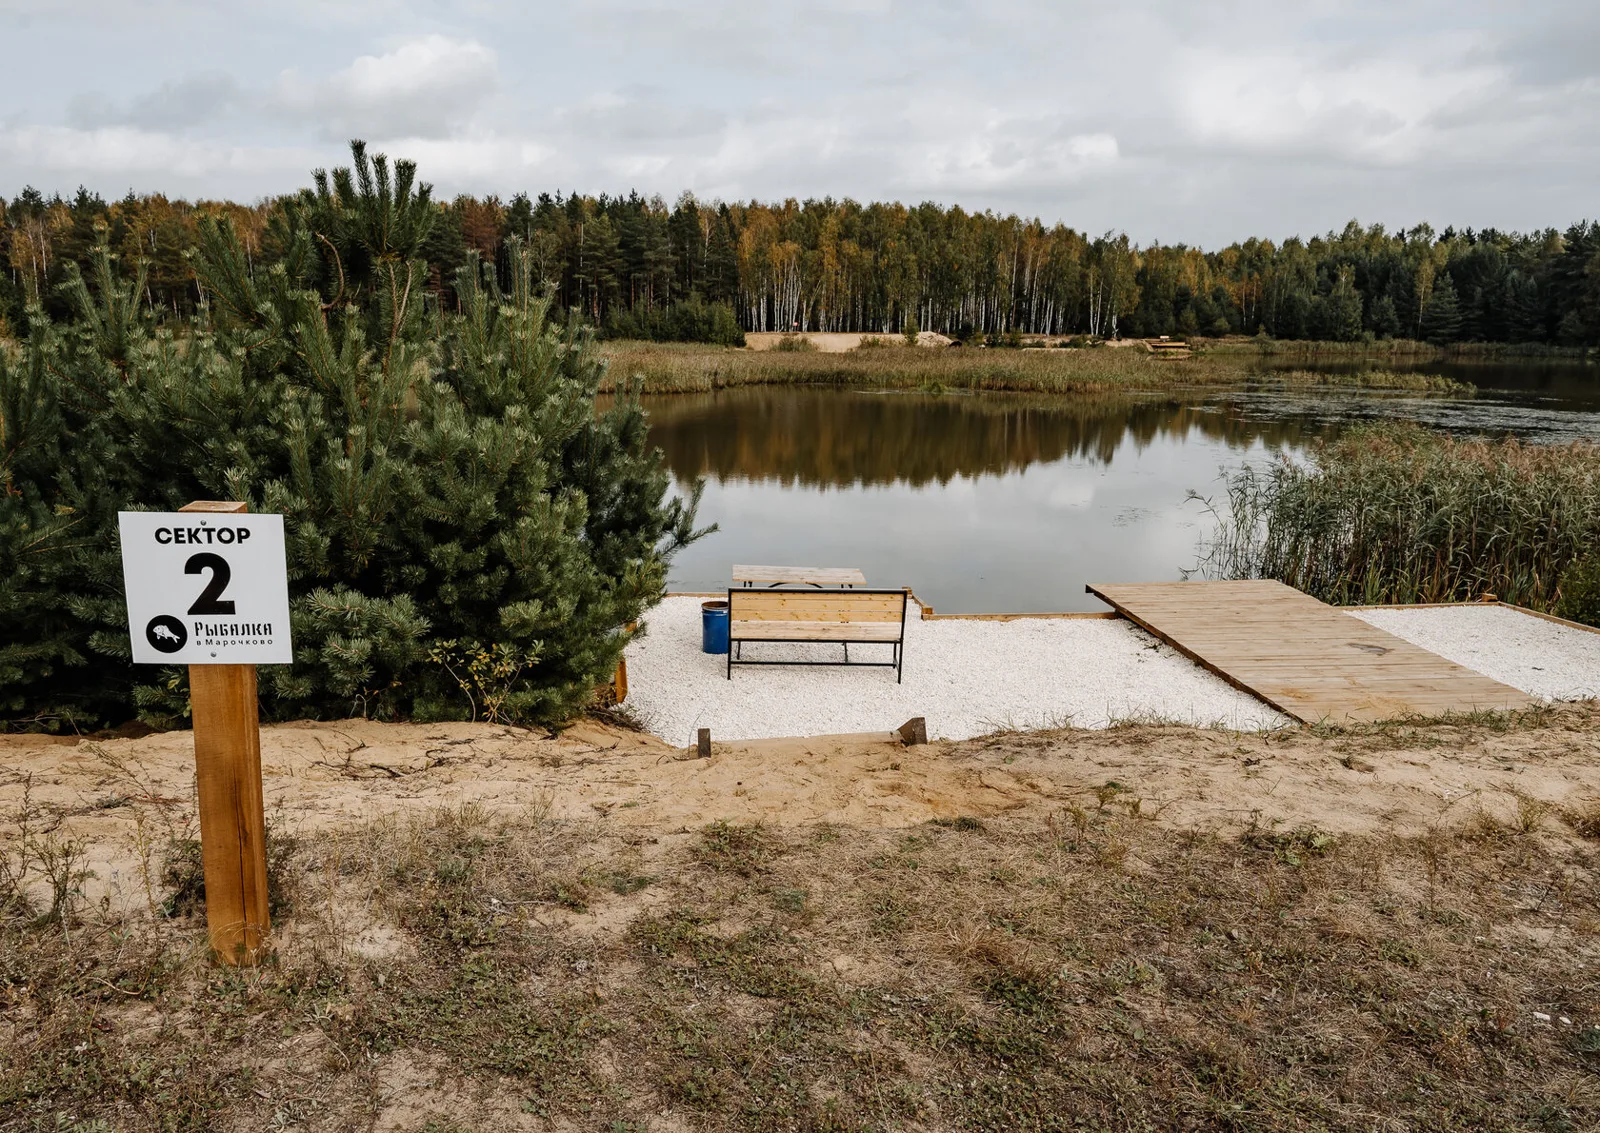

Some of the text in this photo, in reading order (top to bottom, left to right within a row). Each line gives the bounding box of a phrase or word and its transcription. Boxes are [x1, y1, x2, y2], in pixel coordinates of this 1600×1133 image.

[155, 527, 251, 545] СЕКТОР
[184, 552, 236, 616] 2
[205, 638, 273, 647] Марочково
